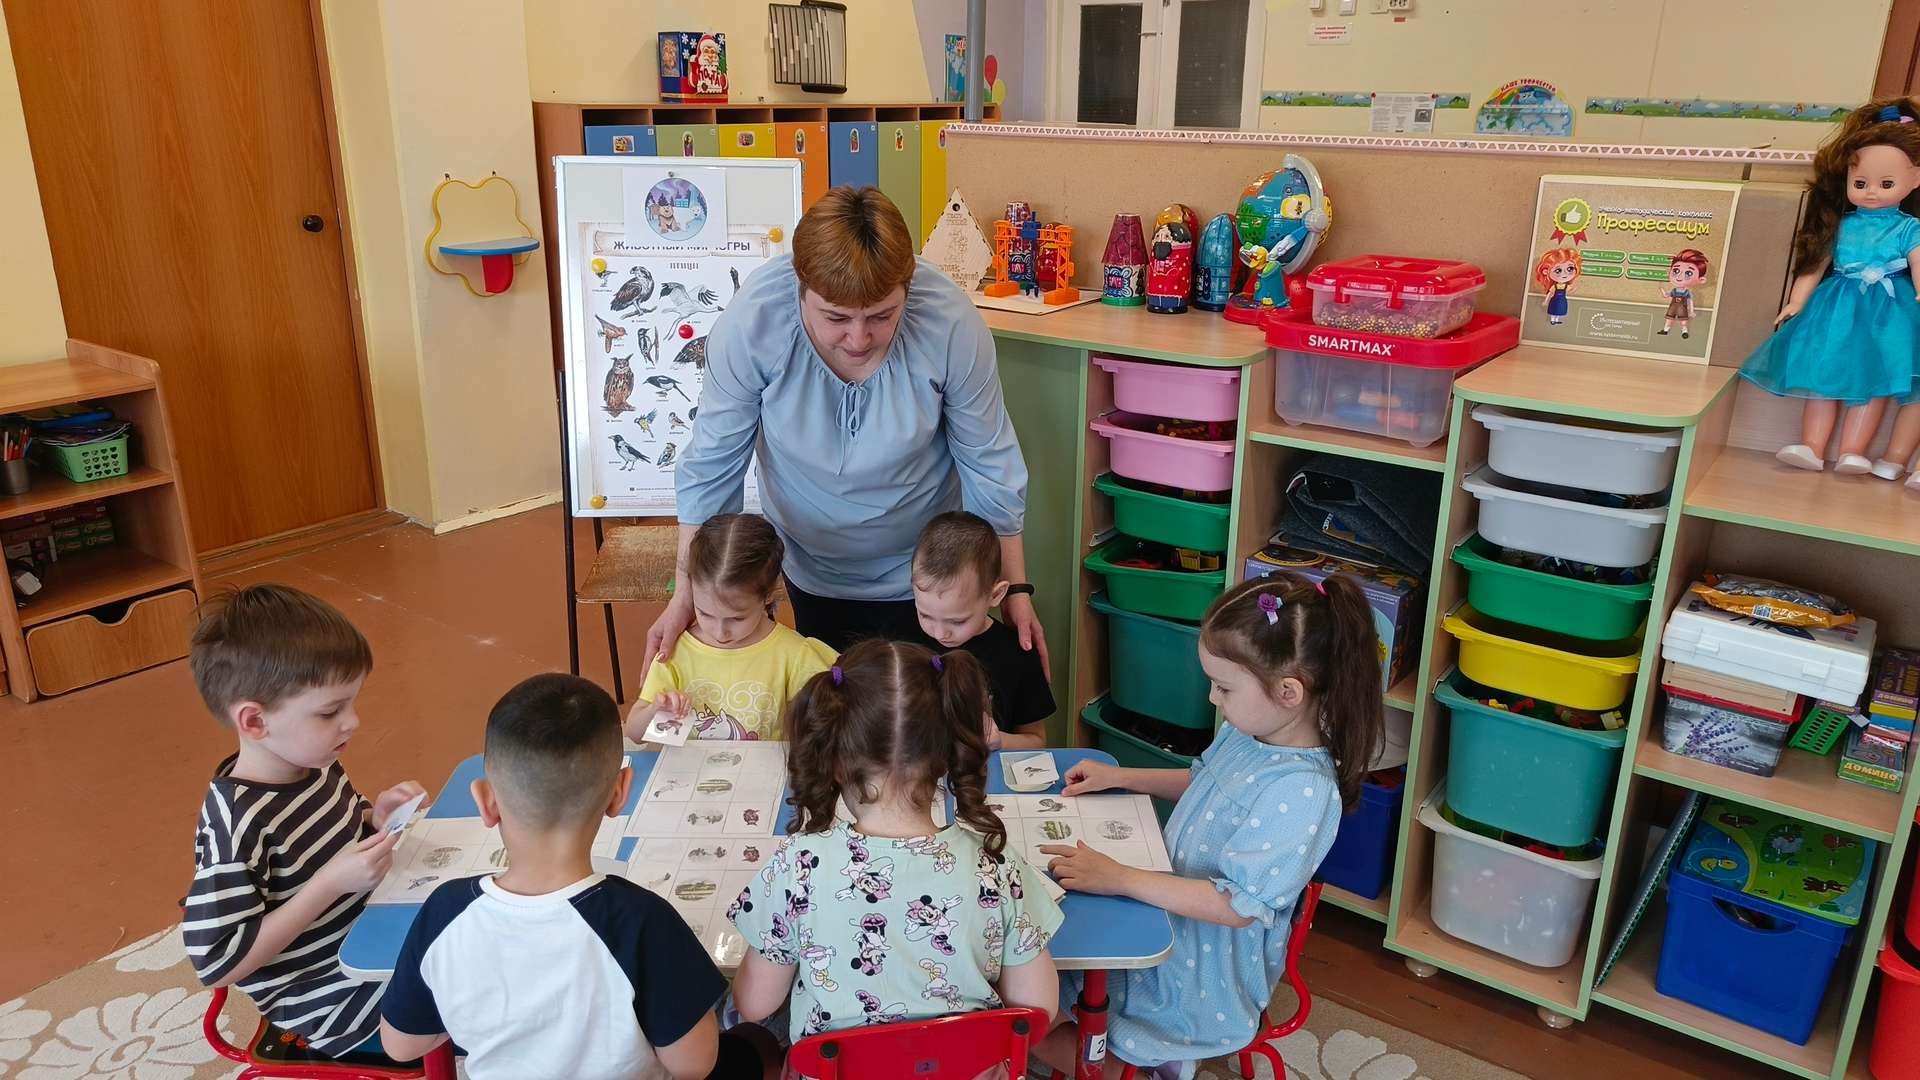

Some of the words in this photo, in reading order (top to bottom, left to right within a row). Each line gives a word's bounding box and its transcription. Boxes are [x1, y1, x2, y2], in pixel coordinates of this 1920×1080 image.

[1598, 213, 1710, 240] Профессиум
[1308, 334, 1392, 356] SMARTMAX
[1844, 762, 1898, 781] ДОМИНО
[1097, 1039, 1105, 1054] 2
